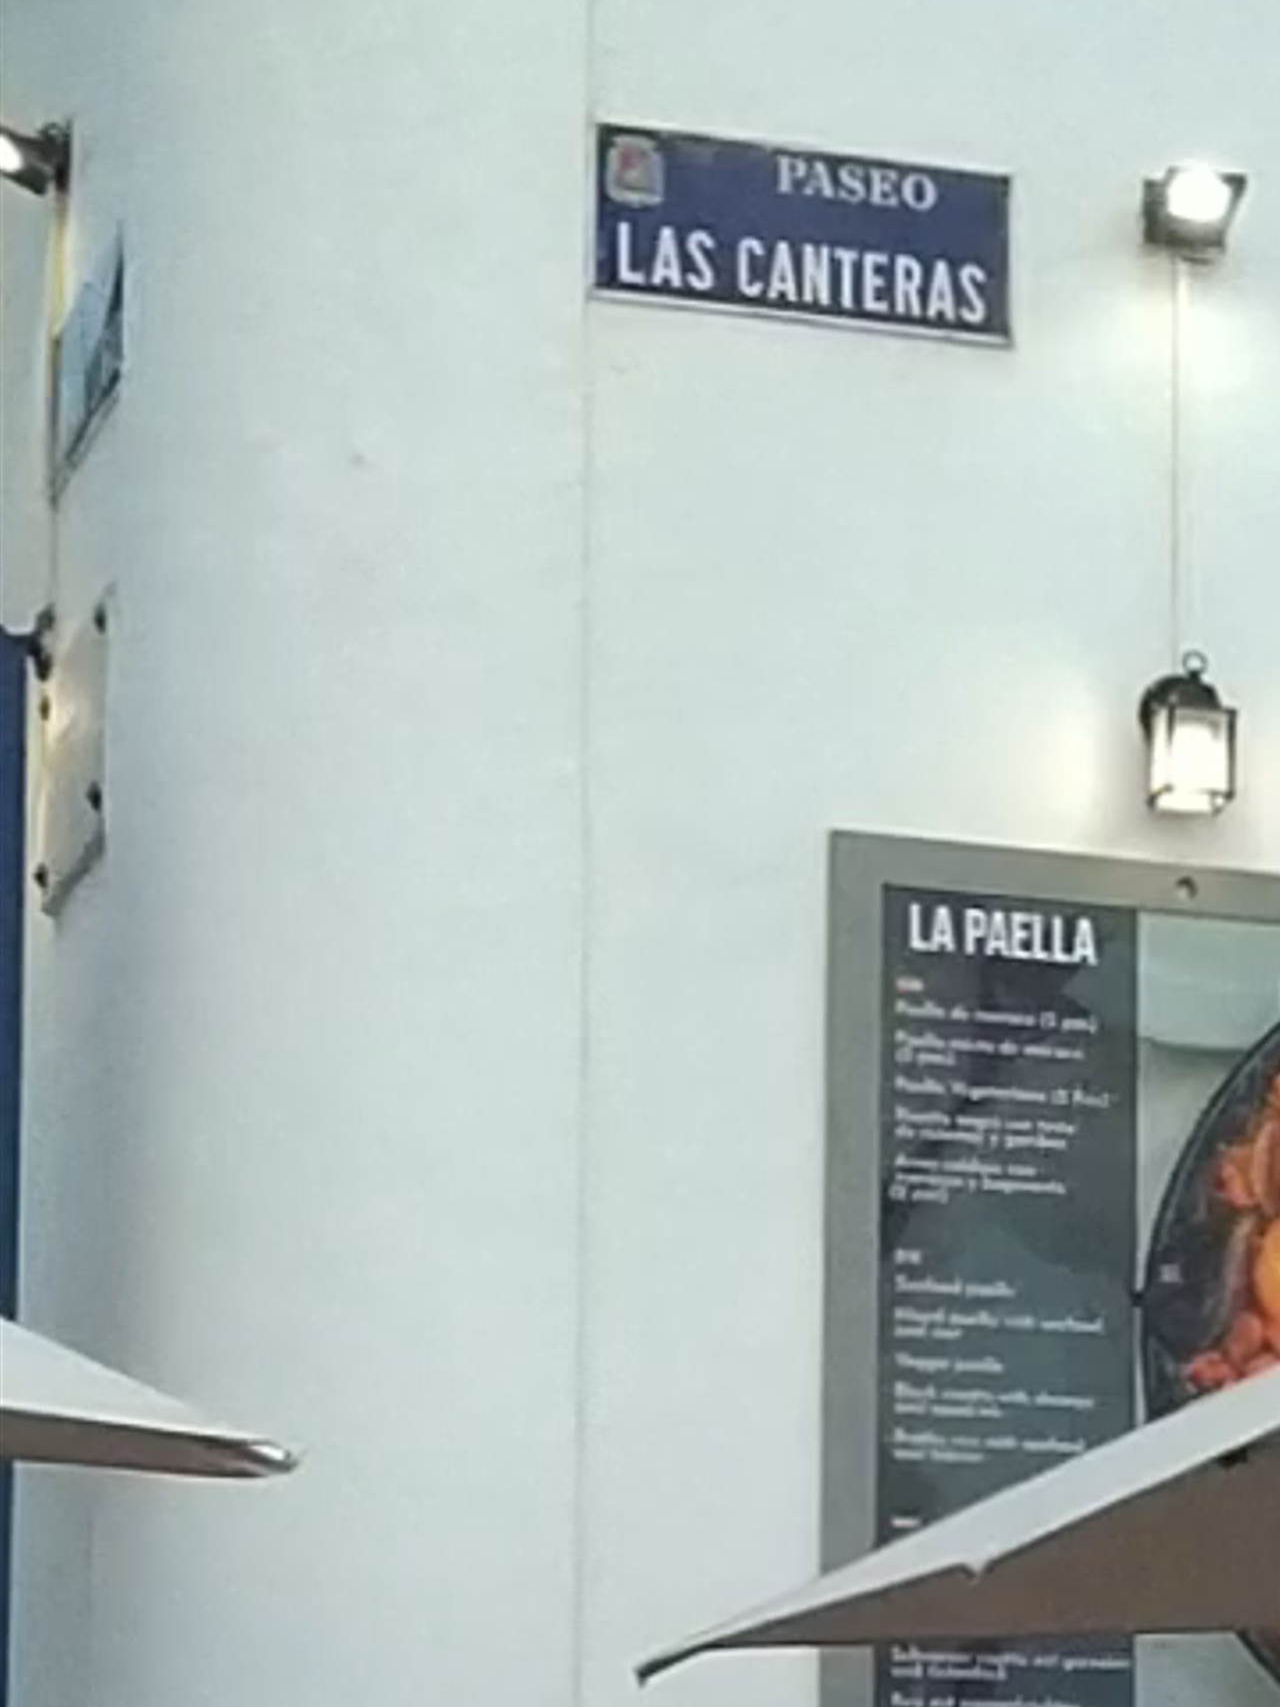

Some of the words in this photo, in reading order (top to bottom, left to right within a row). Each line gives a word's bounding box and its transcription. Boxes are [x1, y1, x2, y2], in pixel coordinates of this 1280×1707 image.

[776, 155, 938, 211] PASEO
[616, 221, 715, 292] LAS
[736, 237, 988, 325] CANTERAS
[908, 902, 955, 953] LA
[964, 907, 1099, 967] PAELLA
